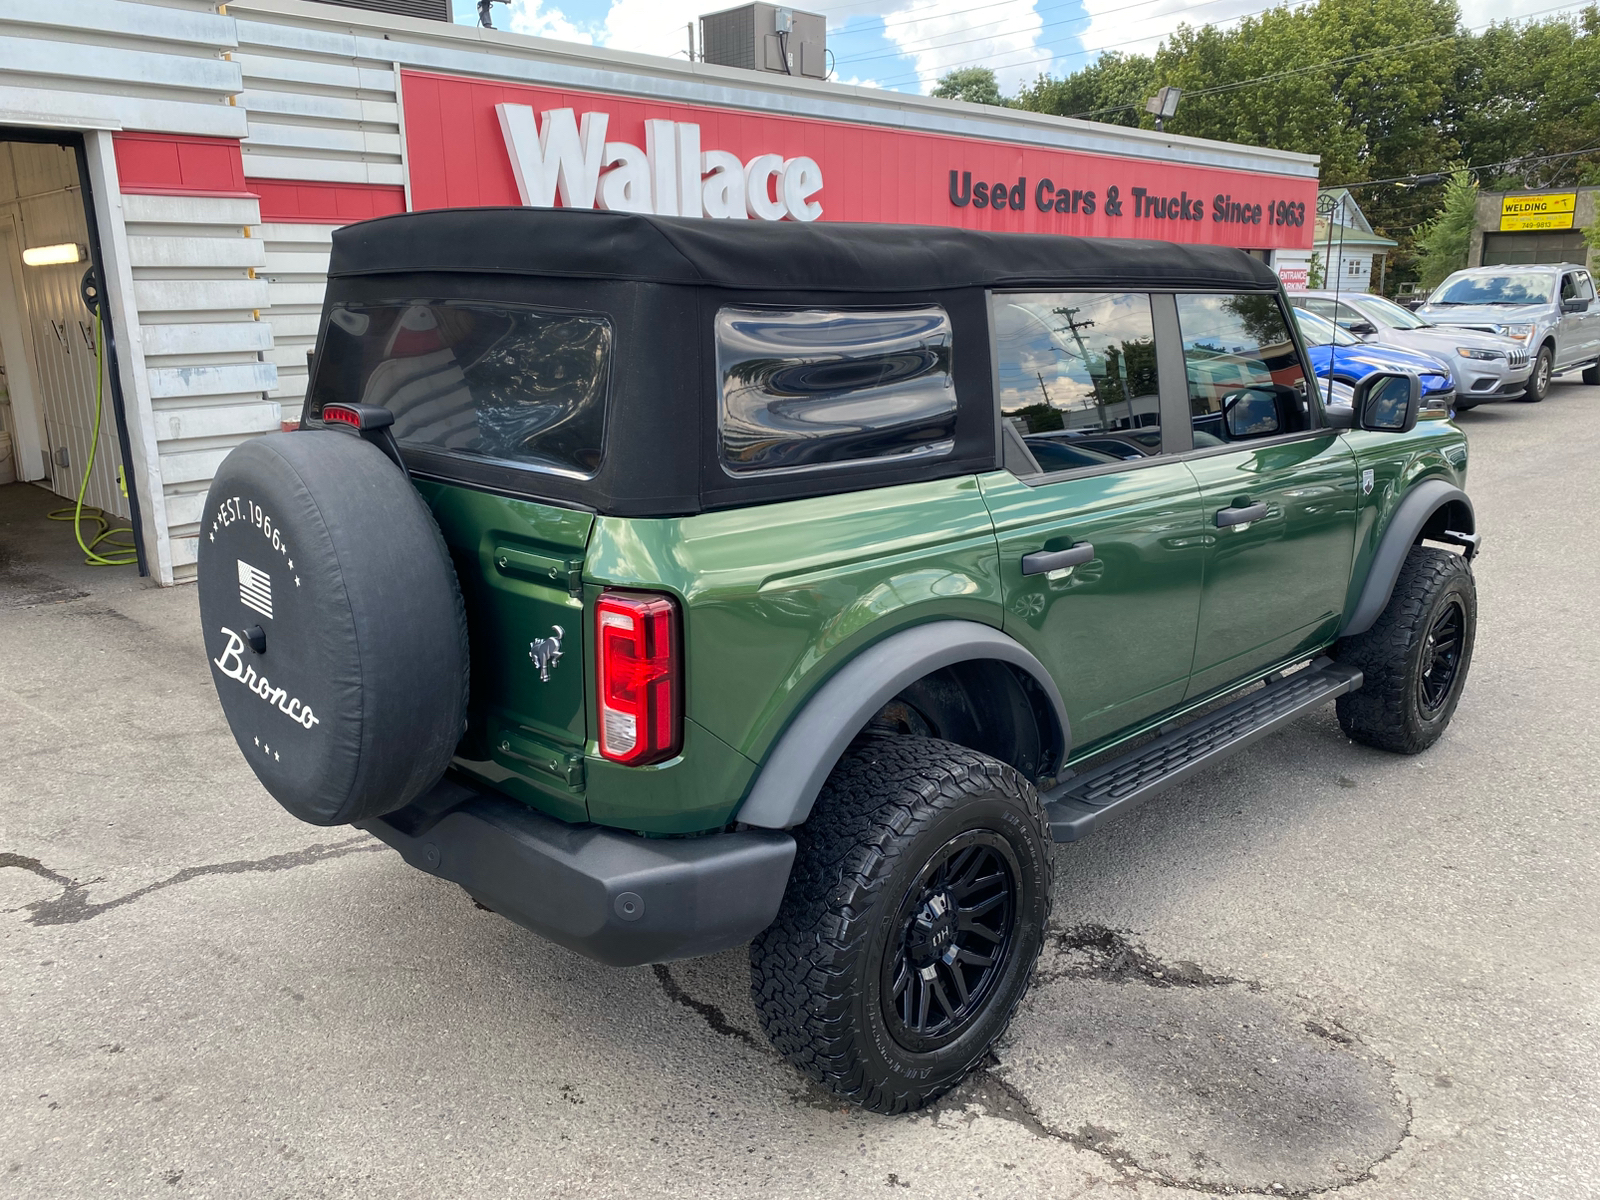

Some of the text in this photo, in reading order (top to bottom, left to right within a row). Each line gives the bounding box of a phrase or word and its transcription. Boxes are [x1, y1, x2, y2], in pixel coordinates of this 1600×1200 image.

[494, 102, 824, 221] Wallace
[949, 170, 1305, 228] Used Cars & Trucks Since 1963
[1505, 203, 1547, 212] WELDING
[1280, 270, 1307, 280] ENTRANCE
[1283, 282, 1307, 290] ARKING
[220, 496, 281, 551] EST. 1966
[213, 626, 320, 730] Bronco
